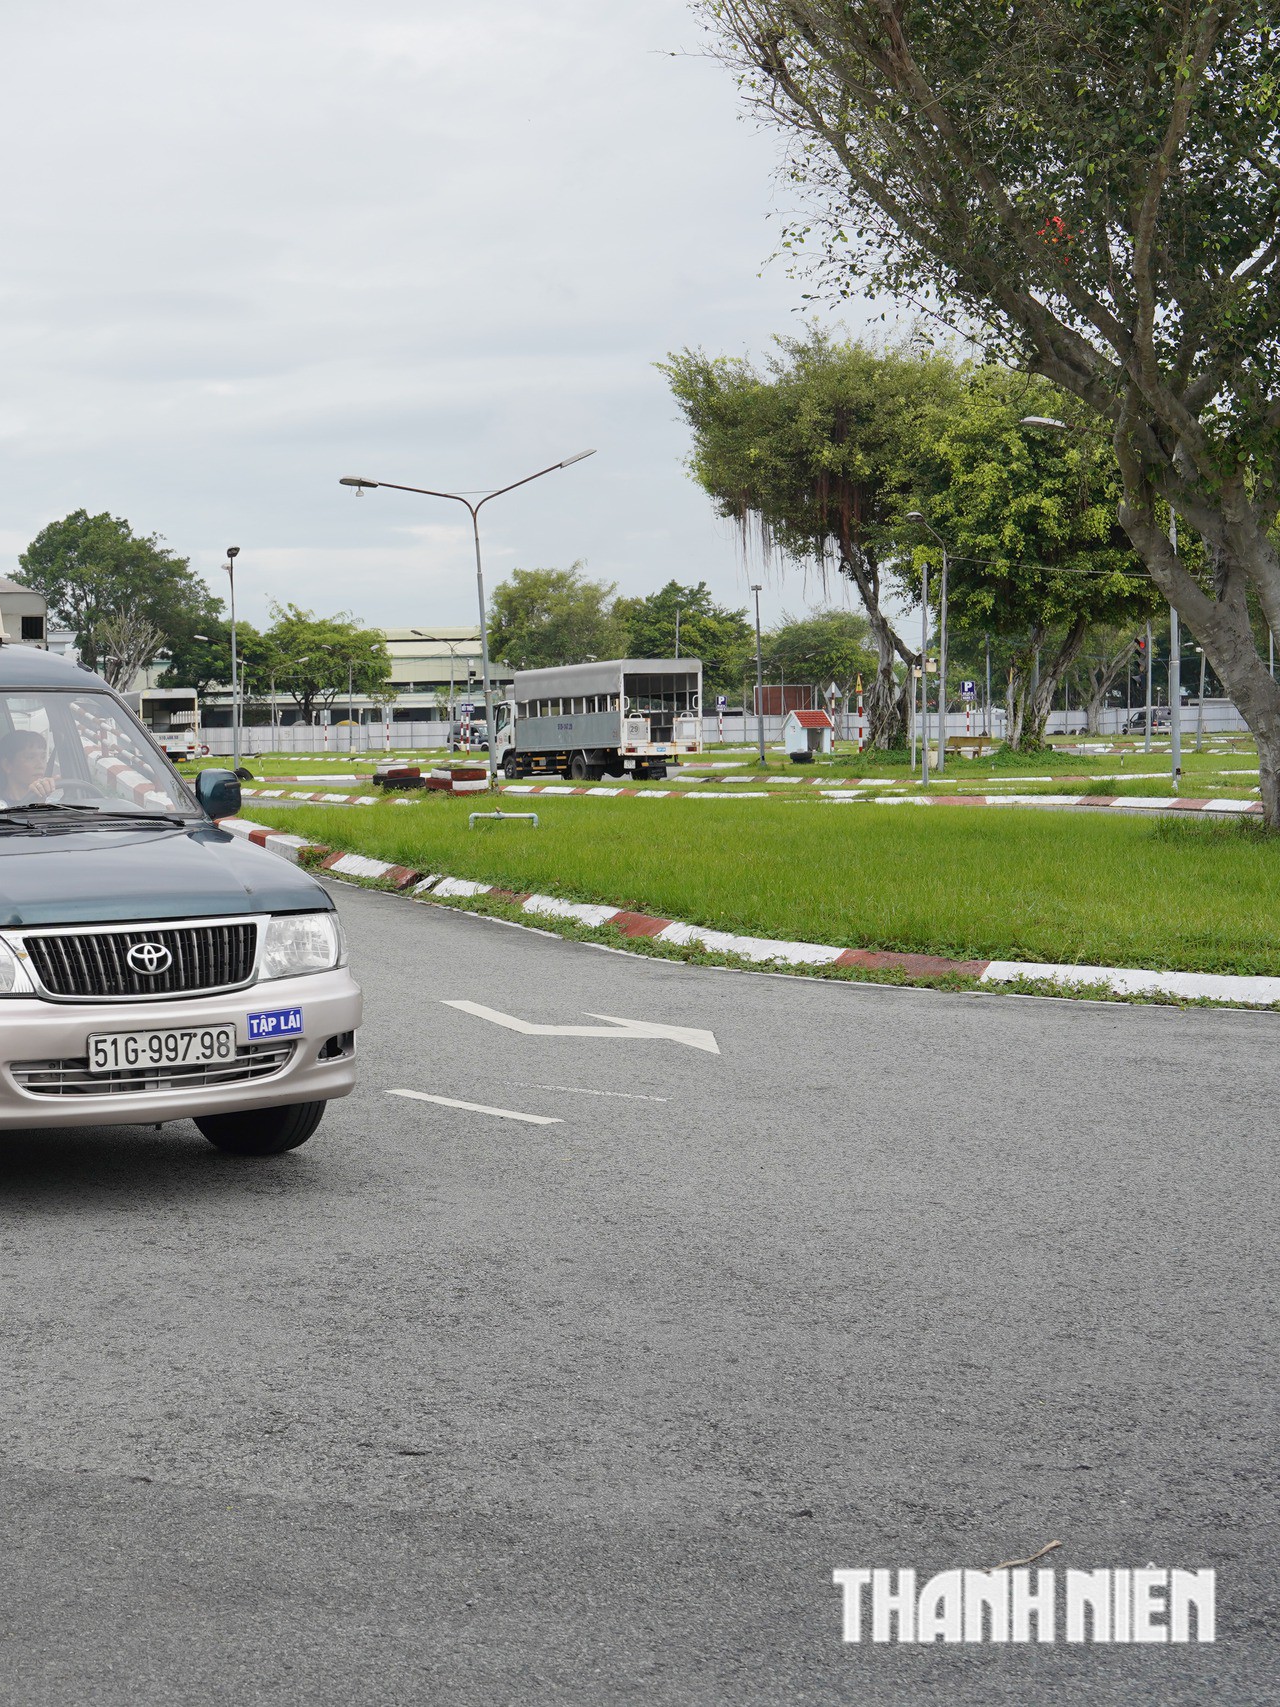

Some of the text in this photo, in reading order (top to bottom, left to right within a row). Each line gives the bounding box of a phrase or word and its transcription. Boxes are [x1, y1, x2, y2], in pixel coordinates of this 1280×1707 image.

[964, 682, 973, 691] P
[718, 696, 724, 704] P
[250, 1012, 301, 1036] TẬP LÁI
[94, 1030, 231, 1068] 51G-997.98
